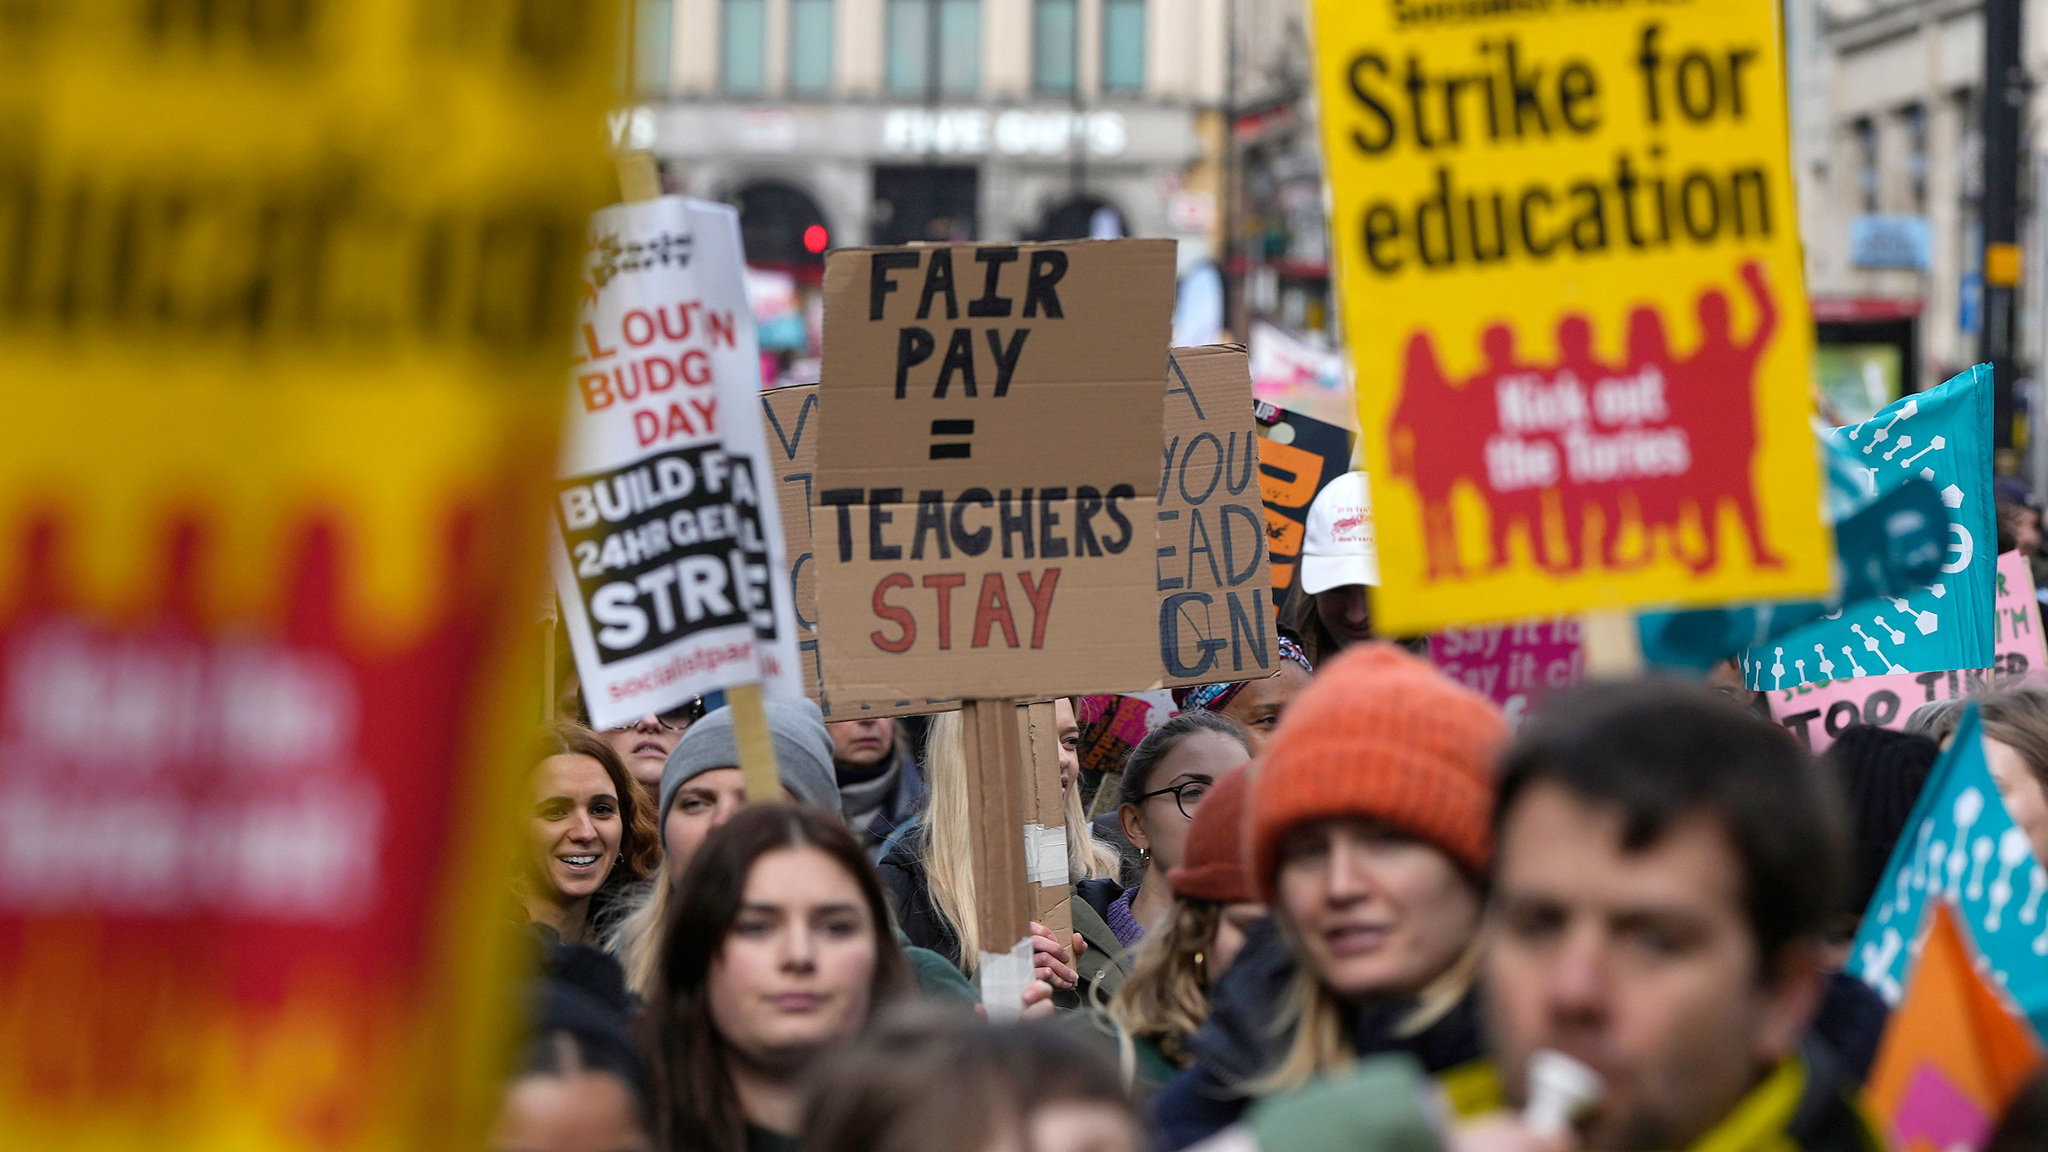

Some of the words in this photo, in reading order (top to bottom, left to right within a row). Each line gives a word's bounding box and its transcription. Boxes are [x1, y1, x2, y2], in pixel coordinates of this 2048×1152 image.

[1344, 37, 1603, 156] Strike
[1639, 22, 1759, 127] for
[1361, 145, 1772, 277] education
[869, 247, 1069, 322] FAIR
[578, 350, 712, 413] BUDG
[895, 327, 1031, 400] PAY
[1594, 362, 1670, 425] out
[633, 396, 718, 447] DAY
[1484, 431, 1560, 492] the
[1564, 425, 1693, 483] Tories
[559, 456, 696, 532] BUILD
[1158, 430, 1253, 506] YOU
[820, 484, 1136, 562] TEACHERS
[1157, 504, 1264, 592] EAD
[591, 549, 775, 651] STRIE
[871, 568, 1061, 653] STAY
[1552, 609, 1583, 644] lo
[1783, 689, 1902, 753] TOO
